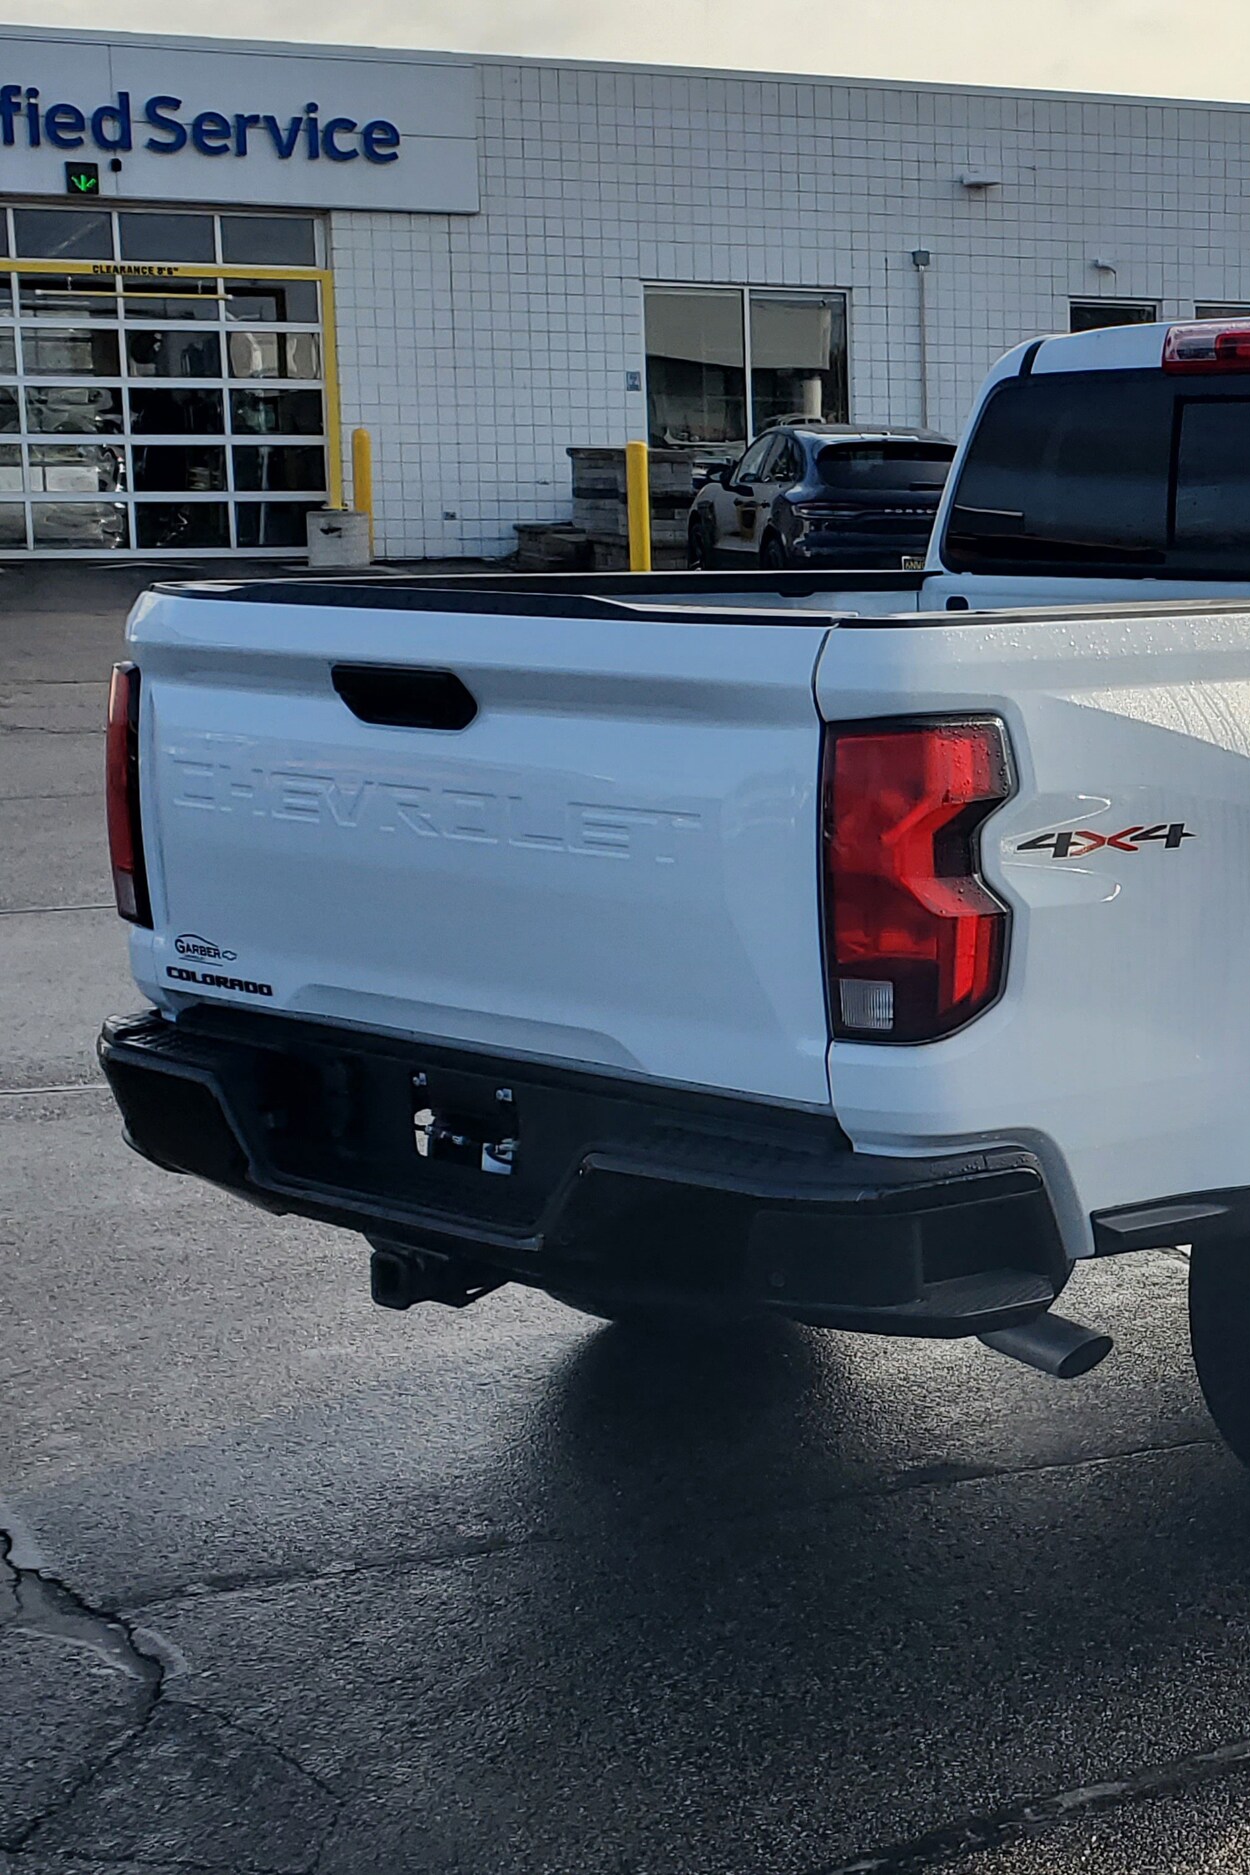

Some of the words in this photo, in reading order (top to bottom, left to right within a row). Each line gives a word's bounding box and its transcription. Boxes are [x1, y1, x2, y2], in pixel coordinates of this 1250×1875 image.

[145, 95, 401, 164] Service
[92, 264, 154, 275] CLEARANCE
[173, 758, 701, 864] CHEVROLET
[175, 939, 221, 959] GARBER
[166, 966, 273, 996] COLORADO
